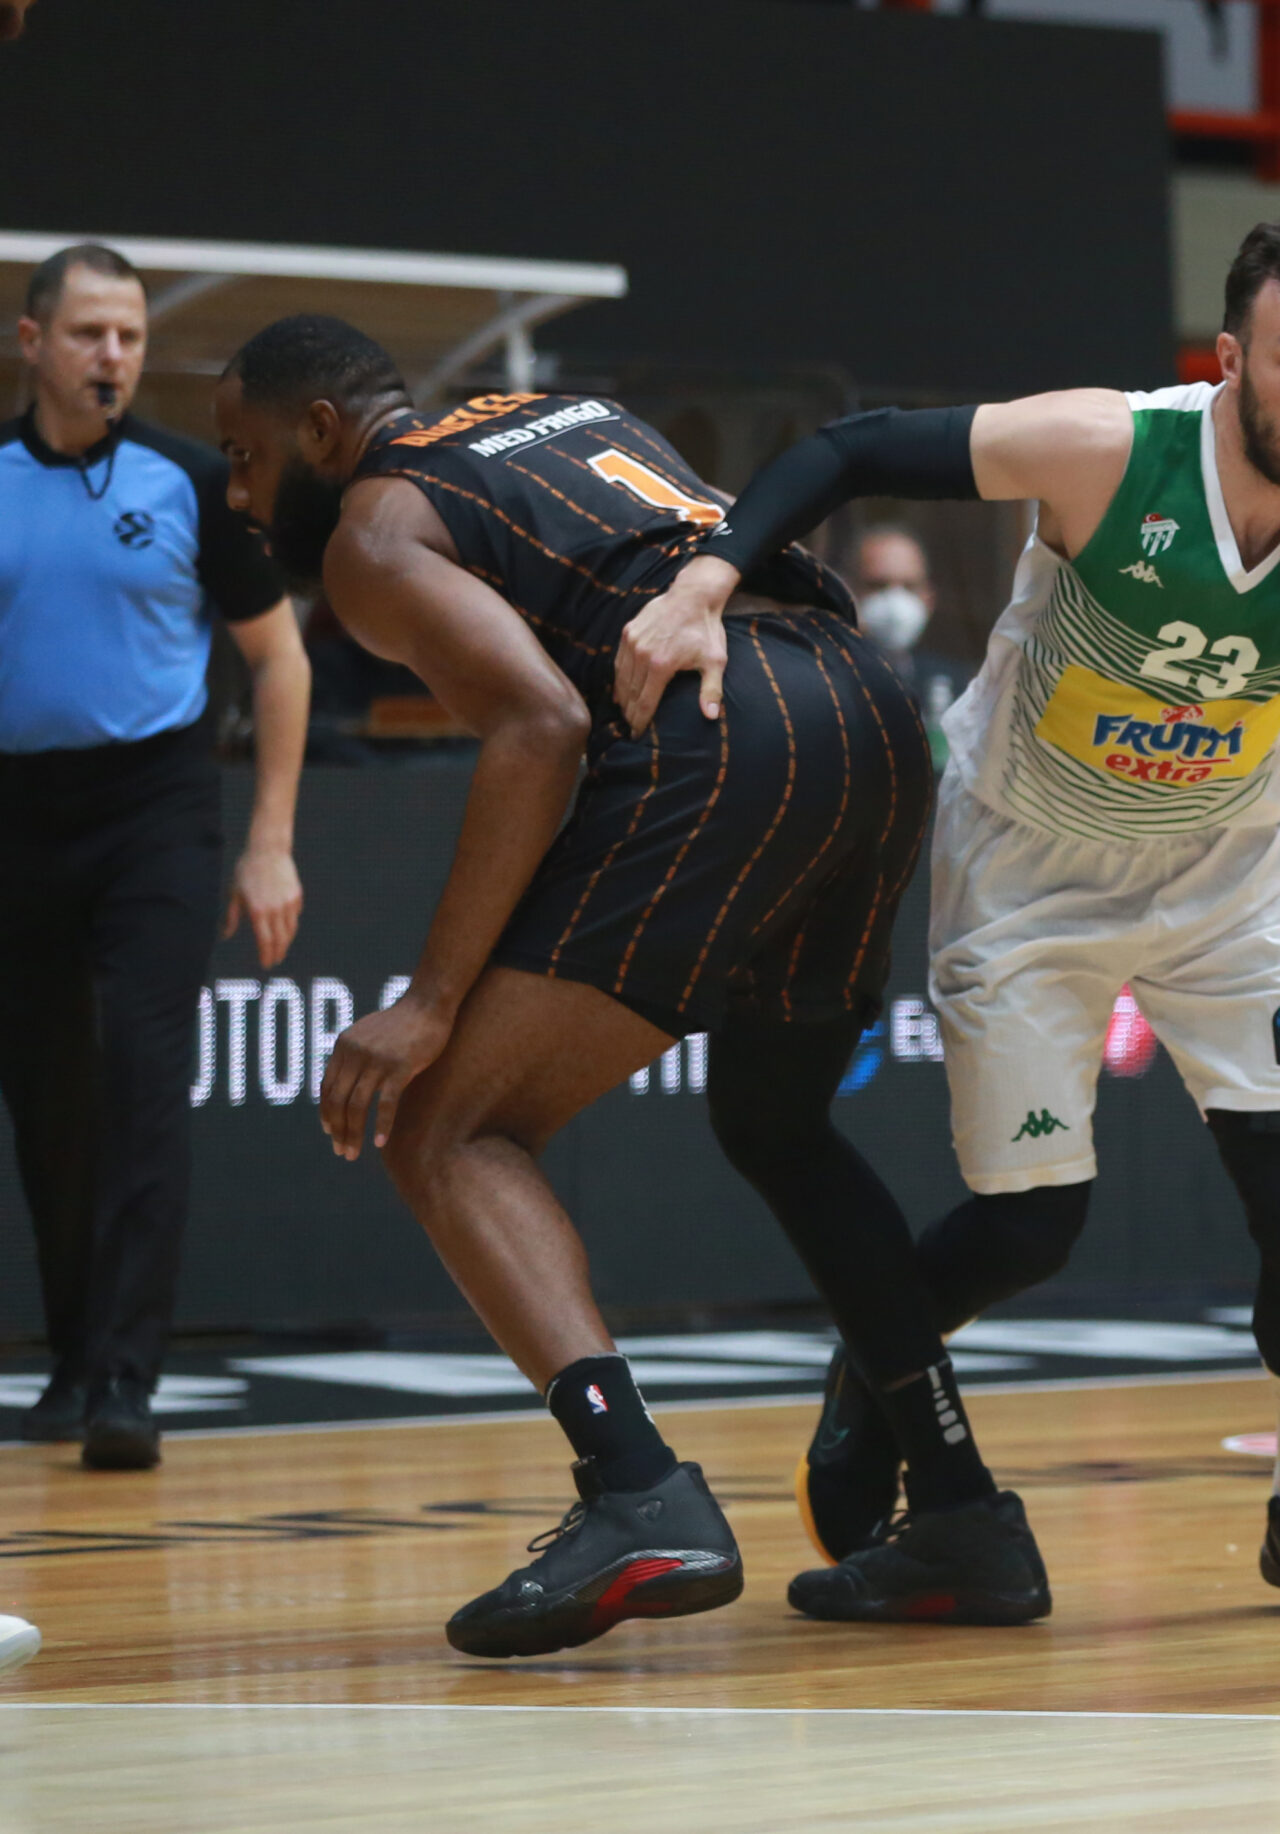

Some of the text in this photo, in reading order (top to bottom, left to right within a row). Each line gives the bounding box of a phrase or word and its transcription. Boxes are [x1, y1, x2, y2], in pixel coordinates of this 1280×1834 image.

[468, 427, 537, 458] MED
[525, 400, 611, 436] FRIGO
[586, 448, 725, 527] 1
[1140, 620, 1260, 699] 23
[1105, 753, 1213, 783] extra
